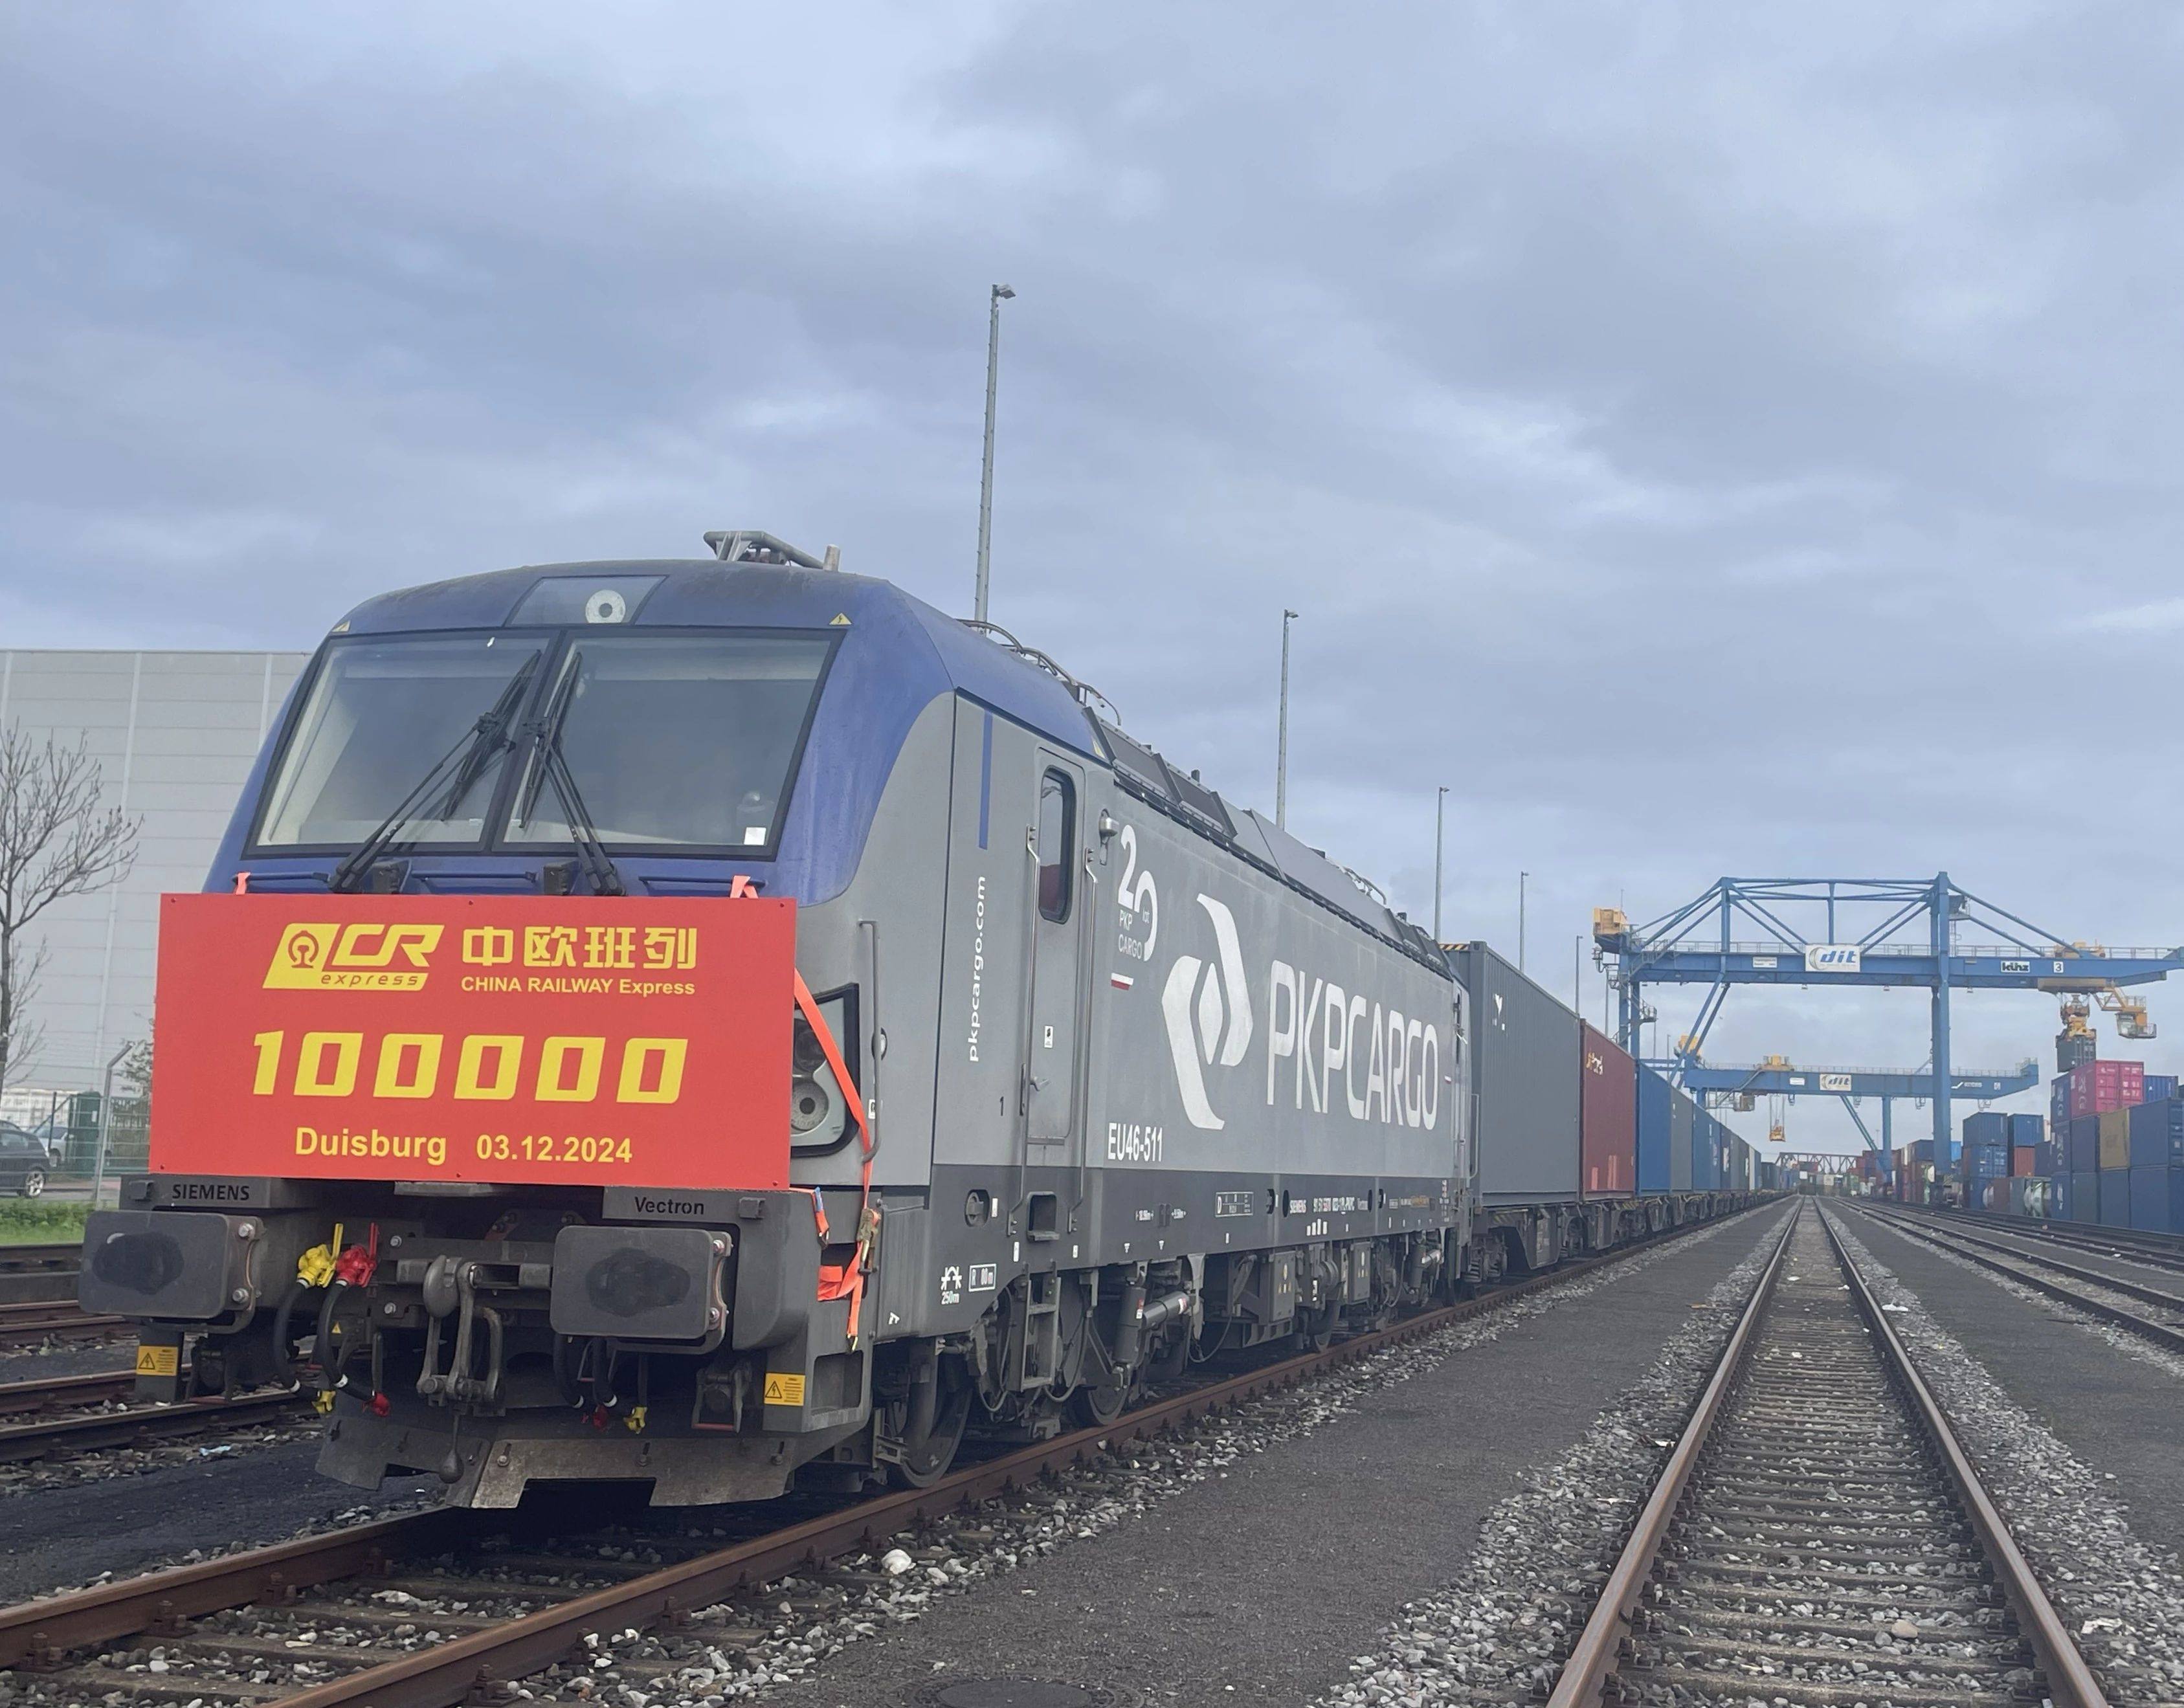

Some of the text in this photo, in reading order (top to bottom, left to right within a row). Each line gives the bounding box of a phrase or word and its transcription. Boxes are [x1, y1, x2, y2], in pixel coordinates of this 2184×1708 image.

[1119, 909, 1133, 931] PKP
[331, 924, 445, 967] CR
[462, 926, 697, 969] 中欧班列
[1118, 934, 1142, 960] CARGO
[1820, 951, 1856, 963] dit
[968, 876, 986, 1062] pkpcargo.com
[2055, 962, 2062, 971] 3
[321, 973, 418, 987] express
[461, 976, 695, 997] CHINA RAILWAY Express
[1267, 959, 1438, 1131] PKPCARGO
[253, 1030, 688, 1104] 100000
[296, 1127, 632, 1166] Duisburg 03.12.2024
[1108, 1122, 1163, 1162] EU46-511
[172, 1184, 249, 1201] SIEMENS
[634, 1196, 704, 1215] Vectron
